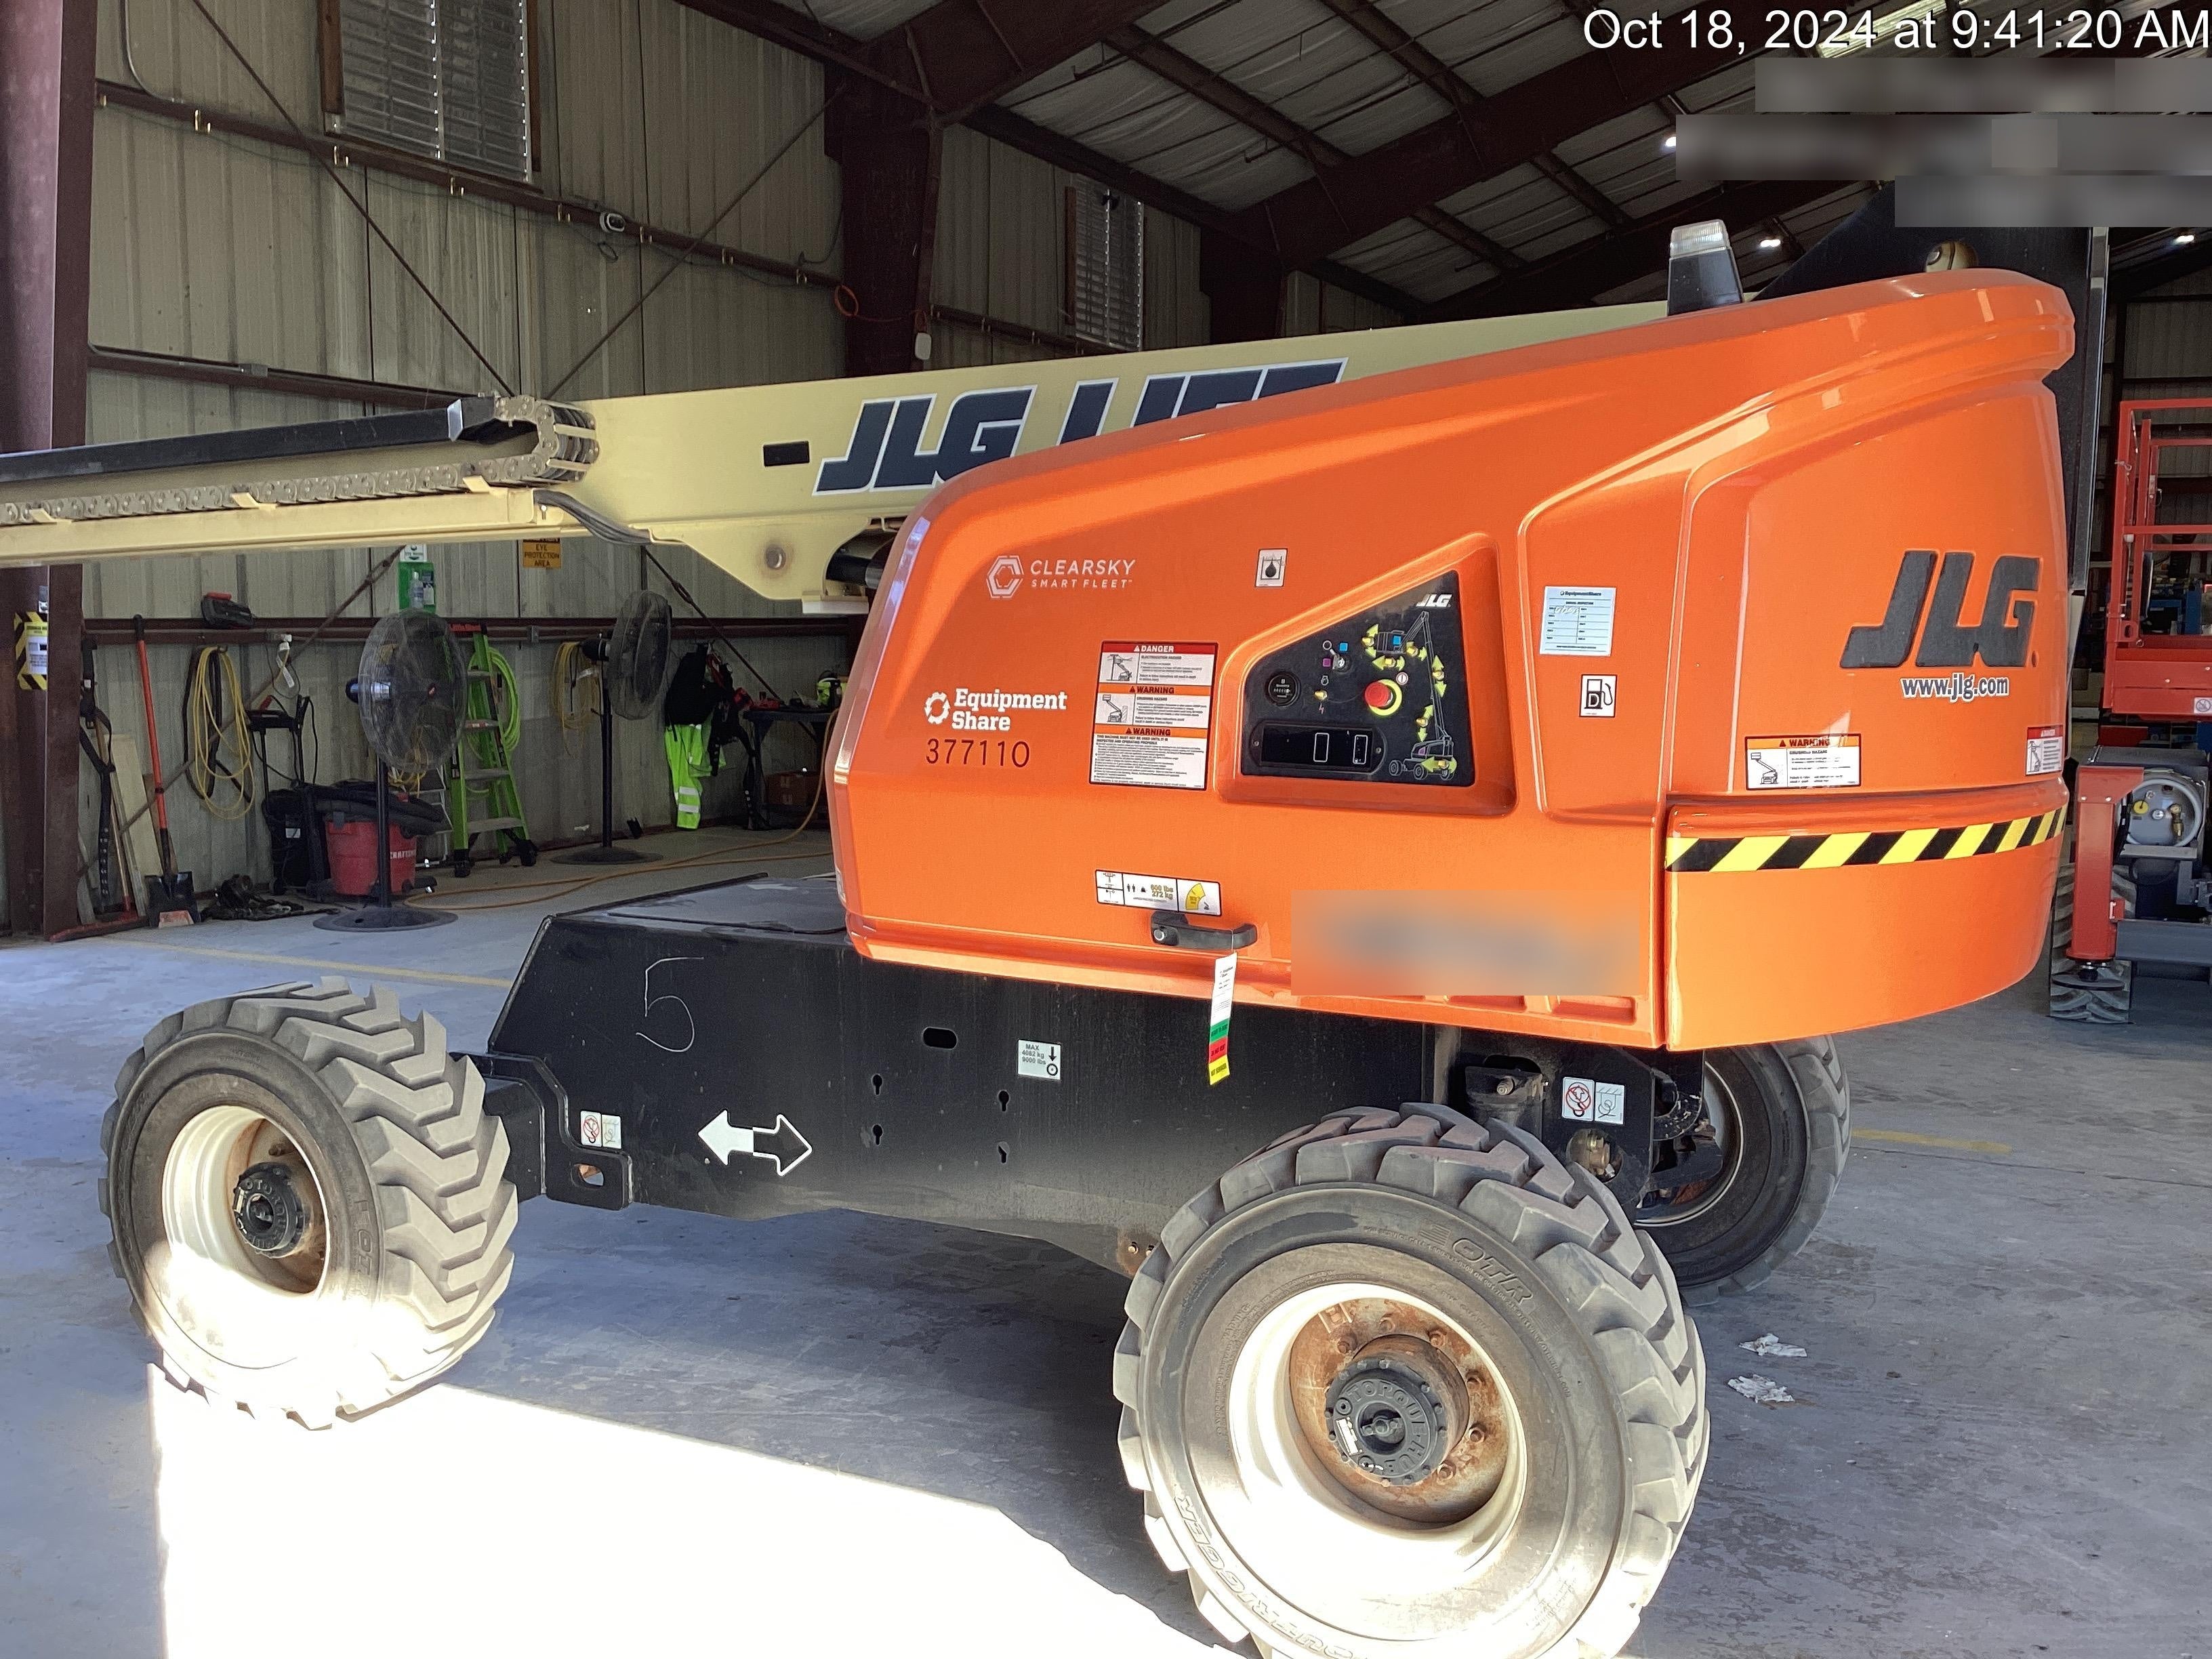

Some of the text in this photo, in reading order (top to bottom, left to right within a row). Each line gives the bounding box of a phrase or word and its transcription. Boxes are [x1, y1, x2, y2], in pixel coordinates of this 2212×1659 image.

[815, 384, 1038, 495] JLG
[1030, 559, 1136, 575] CLEARSKY
[1031, 579, 1076, 588] SMART
[1416, 594, 1452, 607] JLG
[1839, 550, 2041, 668] JLG
[954, 688, 1068, 712] Equipment
[1900, 673, 2009, 702] www.jlg.com
[951, 710, 1011, 731] Share
[1134, 727, 1171, 736] WARNING
[926, 738, 1030, 768] 377110
[636, 957, 704, 1052] 5
[1452, 1237, 1534, 1305] OTR
[1174, 1496, 1353, 1659] OUTRIGGER
